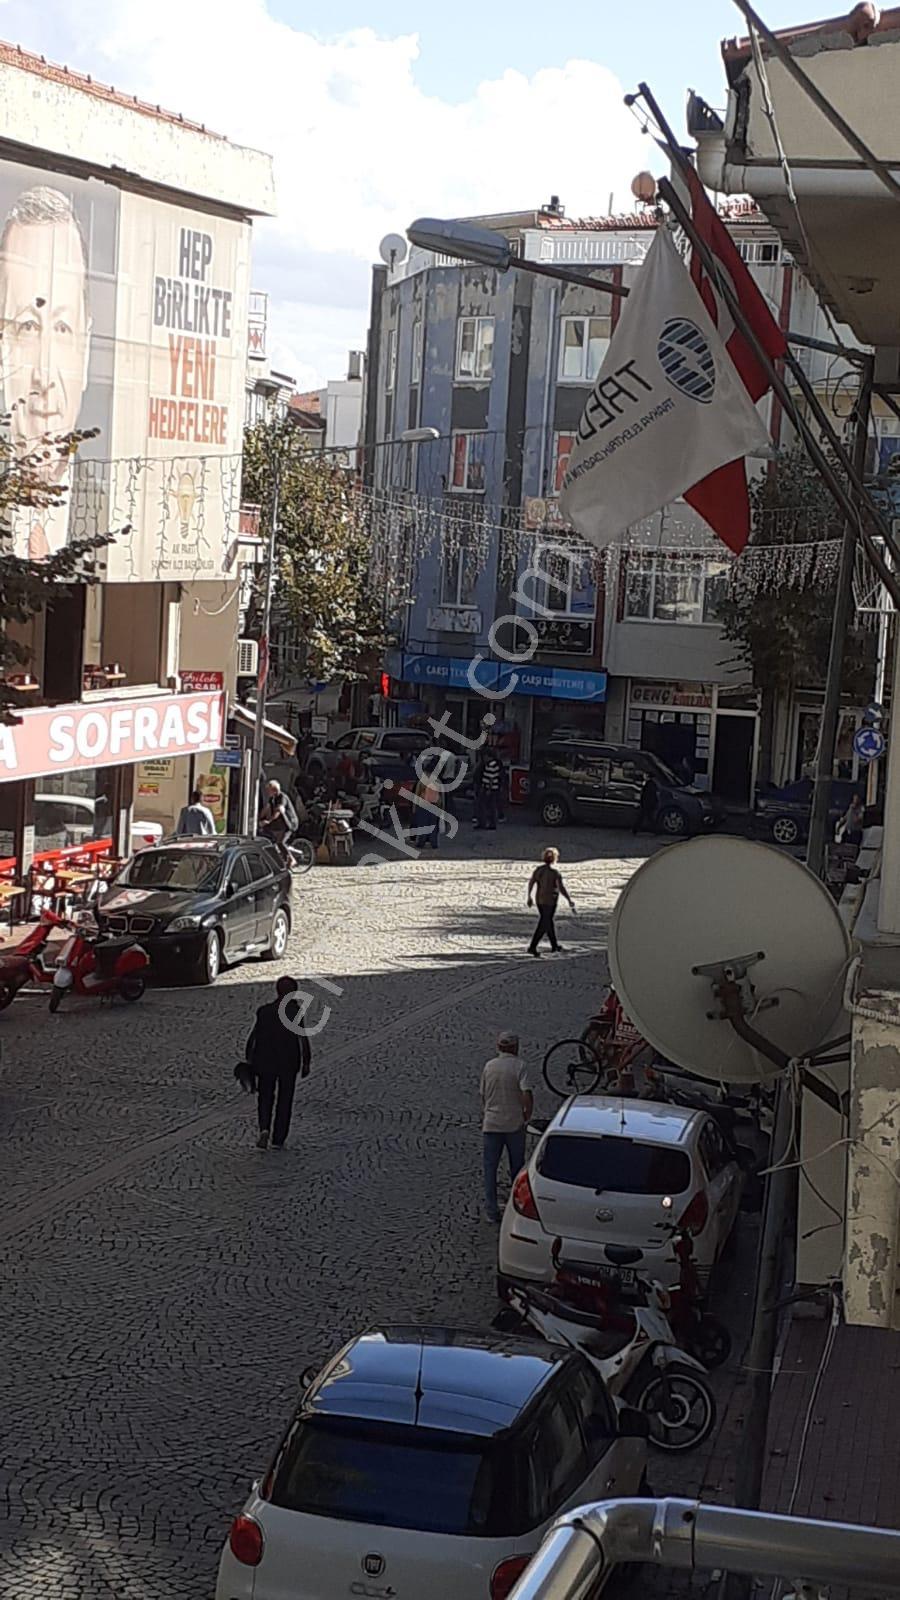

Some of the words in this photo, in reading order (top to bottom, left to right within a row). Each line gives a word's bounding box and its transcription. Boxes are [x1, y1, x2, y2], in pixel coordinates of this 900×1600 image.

[179, 227, 213, 282] HEP
[168, 333, 216, 401] YENİ
[149, 396, 227, 445] HEDEFLERE
[633, 688, 671, 705] GENÇ
[48, 700, 221, 762] SOFRASI
